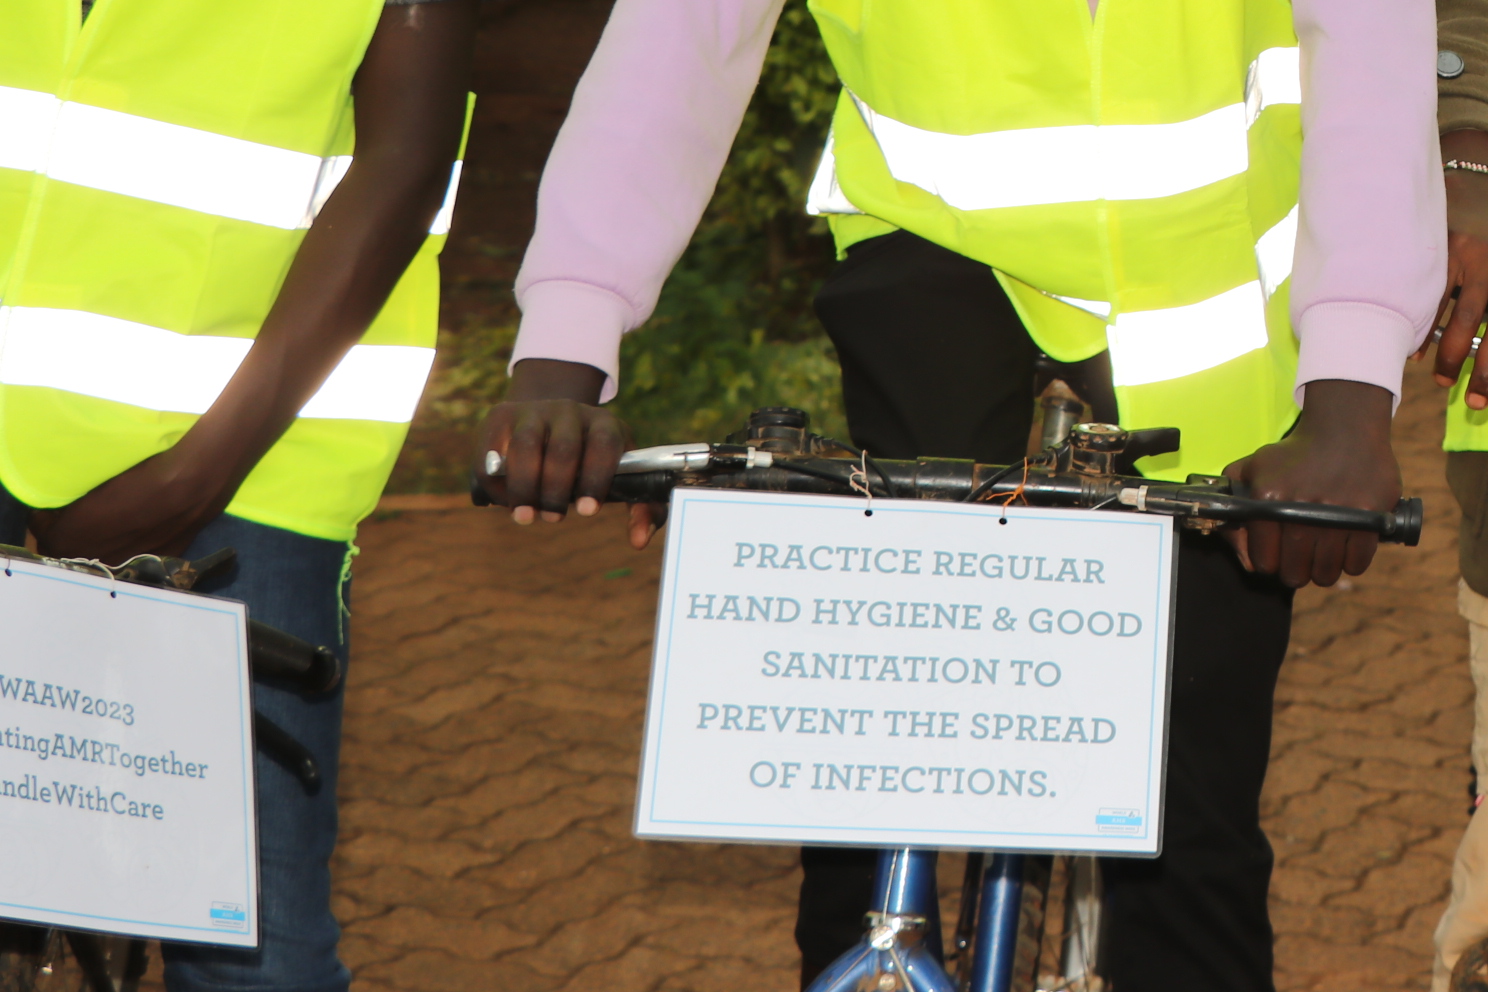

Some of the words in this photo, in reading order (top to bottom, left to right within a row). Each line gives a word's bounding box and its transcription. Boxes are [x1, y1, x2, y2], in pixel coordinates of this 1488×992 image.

[733, 542, 922, 575] PRACTICE
[932, 551, 1105, 584] REGULAR
[687, 594, 801, 623] HAND
[811, 598, 982, 630] HYGIENE
[992, 607, 1017, 632] &
[1029, 608, 1142, 637] GOOD
[761, 651, 1000, 684] SANITATION
[1010, 660, 1061, 687] TO
[697, 703, 873, 736] PREVENT
[883, 710, 959, 740] THE
[970, 713, 1116, 744] SPREAD
[0, 773, 164, 820] ndleWithCare
[750, 761, 801, 789] OF
[810, 763, 1057, 798] INFECTIONS.
